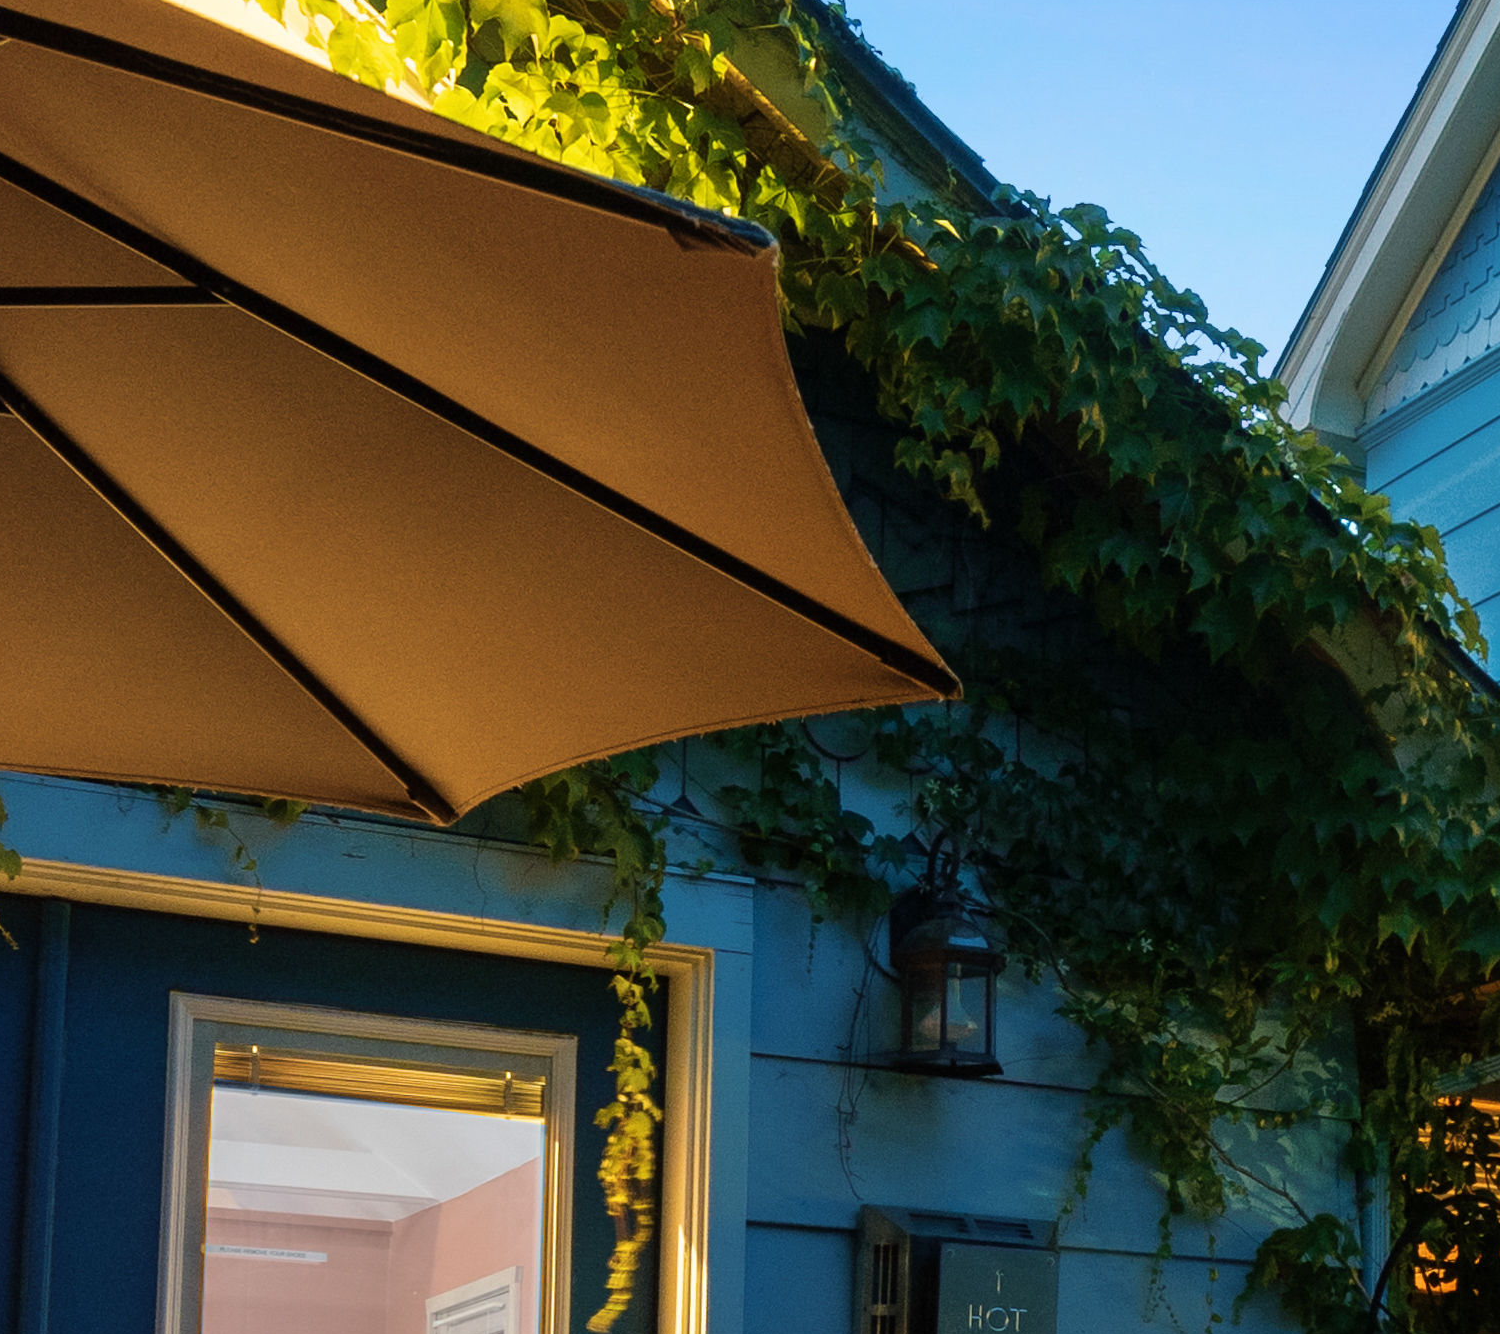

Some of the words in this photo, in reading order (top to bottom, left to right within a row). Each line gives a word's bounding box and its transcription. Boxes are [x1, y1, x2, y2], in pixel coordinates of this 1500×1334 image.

[219, 1246, 241, 1254] PLEASE
[242, 1248, 268, 1256] REMOVE
[969, 1304, 1028, 1332] HOT
